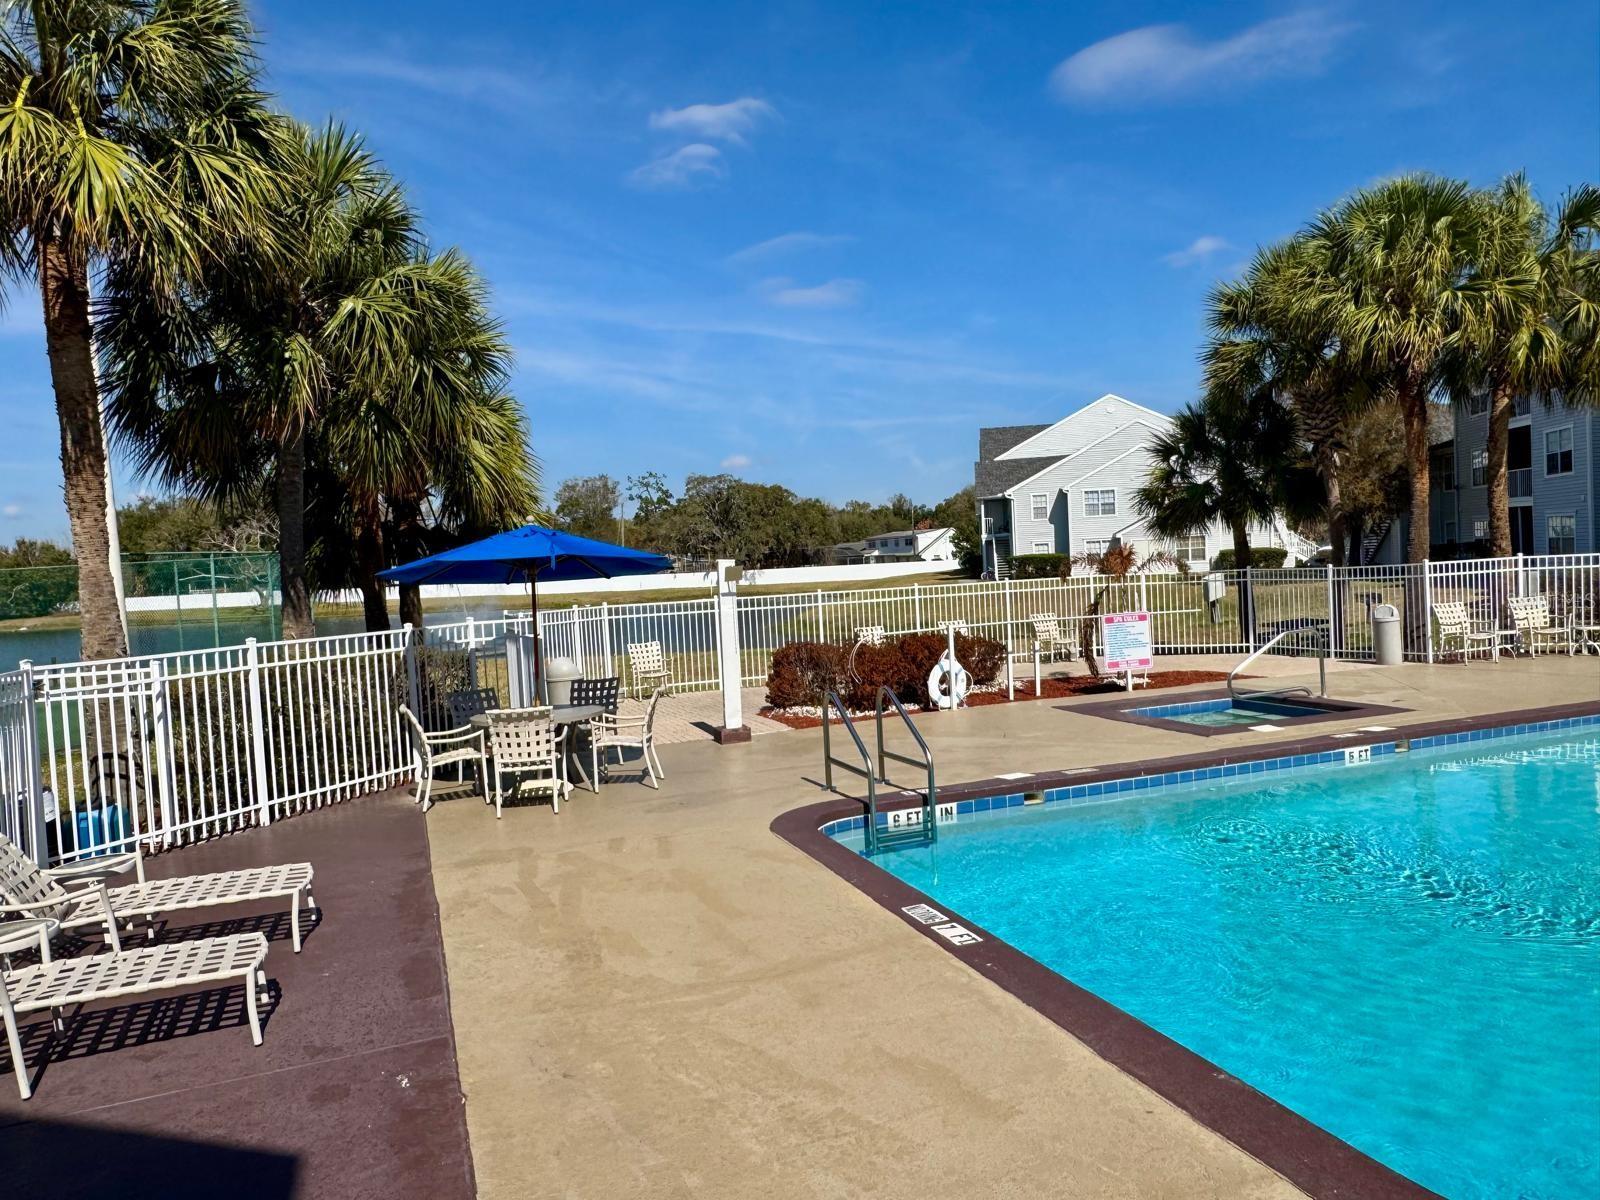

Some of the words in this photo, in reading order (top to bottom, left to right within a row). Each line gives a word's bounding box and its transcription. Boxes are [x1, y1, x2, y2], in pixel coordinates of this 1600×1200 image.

[1358, 748, 1369, 760] FT
[906, 810, 921, 823] FT
[940, 806, 953, 817] IN
[950, 933, 979, 943] FT
